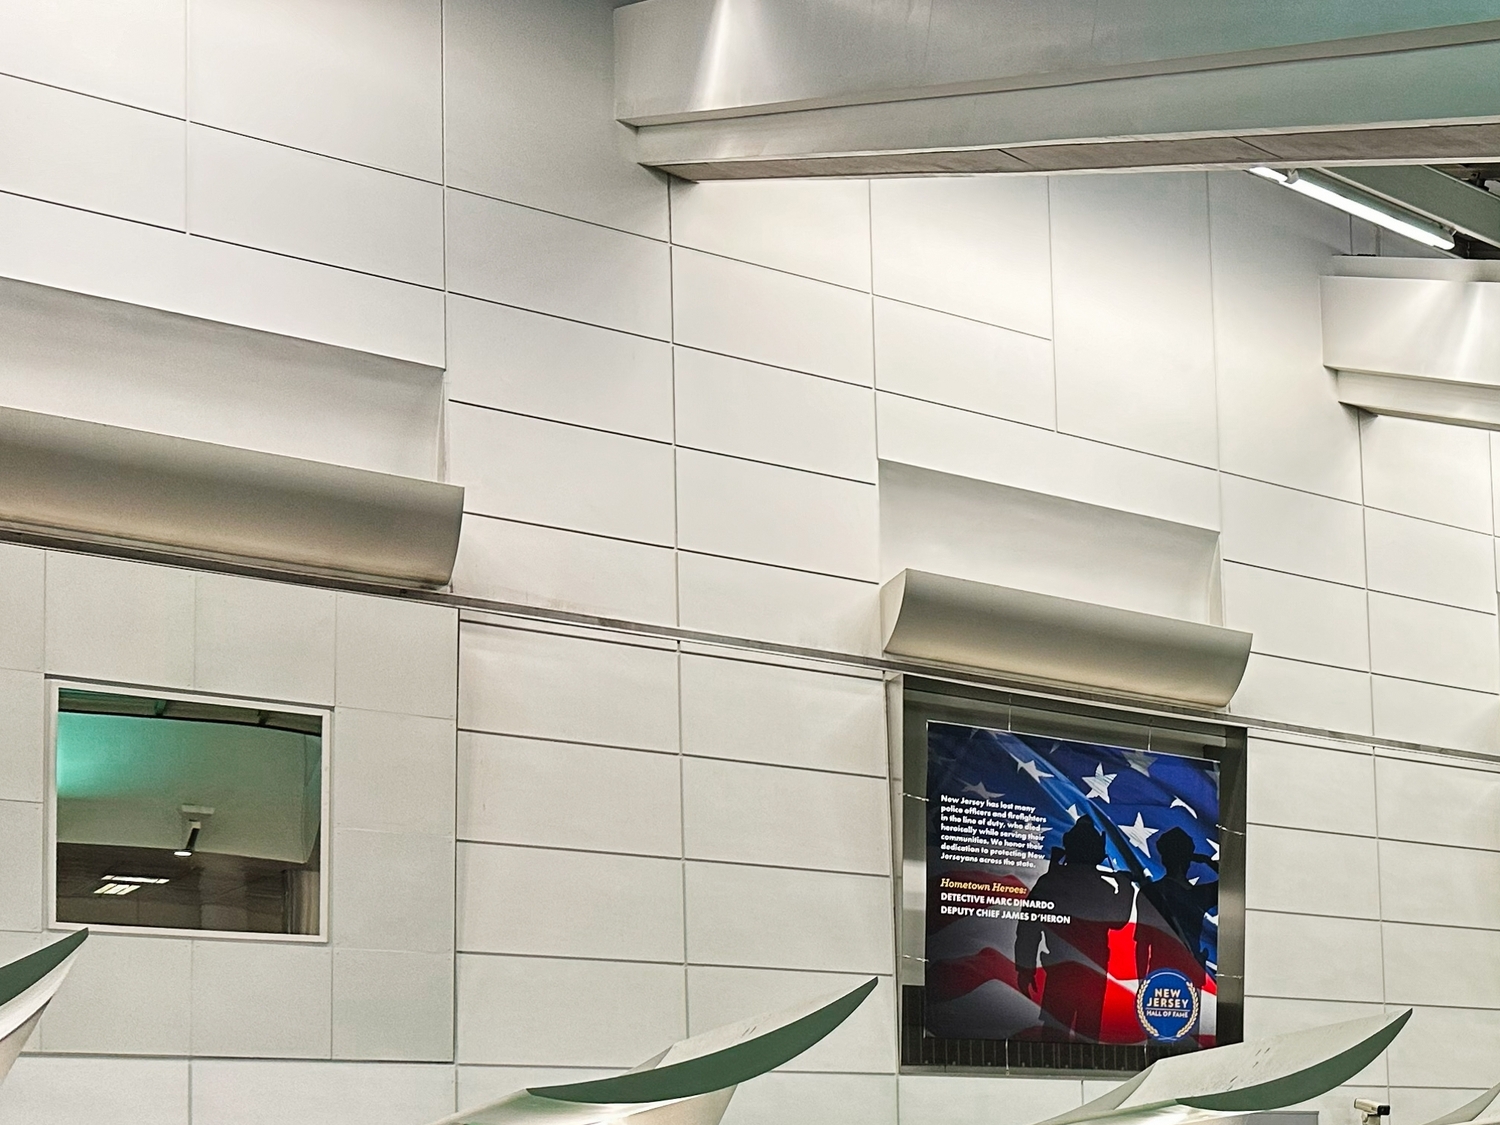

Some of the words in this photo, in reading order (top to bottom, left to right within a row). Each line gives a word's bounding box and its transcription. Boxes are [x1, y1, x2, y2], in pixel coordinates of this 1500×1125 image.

[941, 795, 959, 803] New
[961, 797, 985, 808] Jersey
[986, 799, 999, 808] has
[1000, 801, 1014, 810] lost
[1015, 805, 1036, 814] many
[941, 806, 963, 814] police
[964, 807, 991, 817] officers
[1007, 812, 1047, 823] firefighters
[949, 815, 961, 823] the
[962, 816, 976, 824] line
[987, 819, 1006, 829] duty,
[1007, 821, 1023, 830] who
[1025, 823, 1041, 831] died
[941, 823, 977, 835] heroically
[979, 828, 999, 836] while
[1000, 831, 1027, 841] serving
[1028, 833, 1045, 841] their
[941, 835, 989, 845] communities.
[991, 838, 1003, 846] We
[1004, 839, 1025, 848] honor
[1027, 842, 1044, 850] their
[941, 842, 980, 853] dedication
[990, 848, 1026, 860] protecting
[1028, 852, 1045, 860] New
[941, 852, 979, 863] Jerseyans
[979, 857, 1002, 865] across
[1003, 858, 1015, 866] the
[1016, 860, 1037, 868] state.
[940, 878, 991, 891] Hometown
[992, 883, 1028, 894] Heroes:
[940, 893, 985, 904] DETECTIVE
[986, 896, 1012, 906] MARC
[1013, 899, 1055, 910] DINARDO
[940, 906, 975, 916] DEPUTY
[976, 908, 1000, 919] CHIEF
[1001, 911, 1029, 921] JAMES
[1031, 913, 1071, 924] D'HERON
[1154, 988, 1181, 998] NEW
[1146, 997, 1189, 1008] JERSEY
